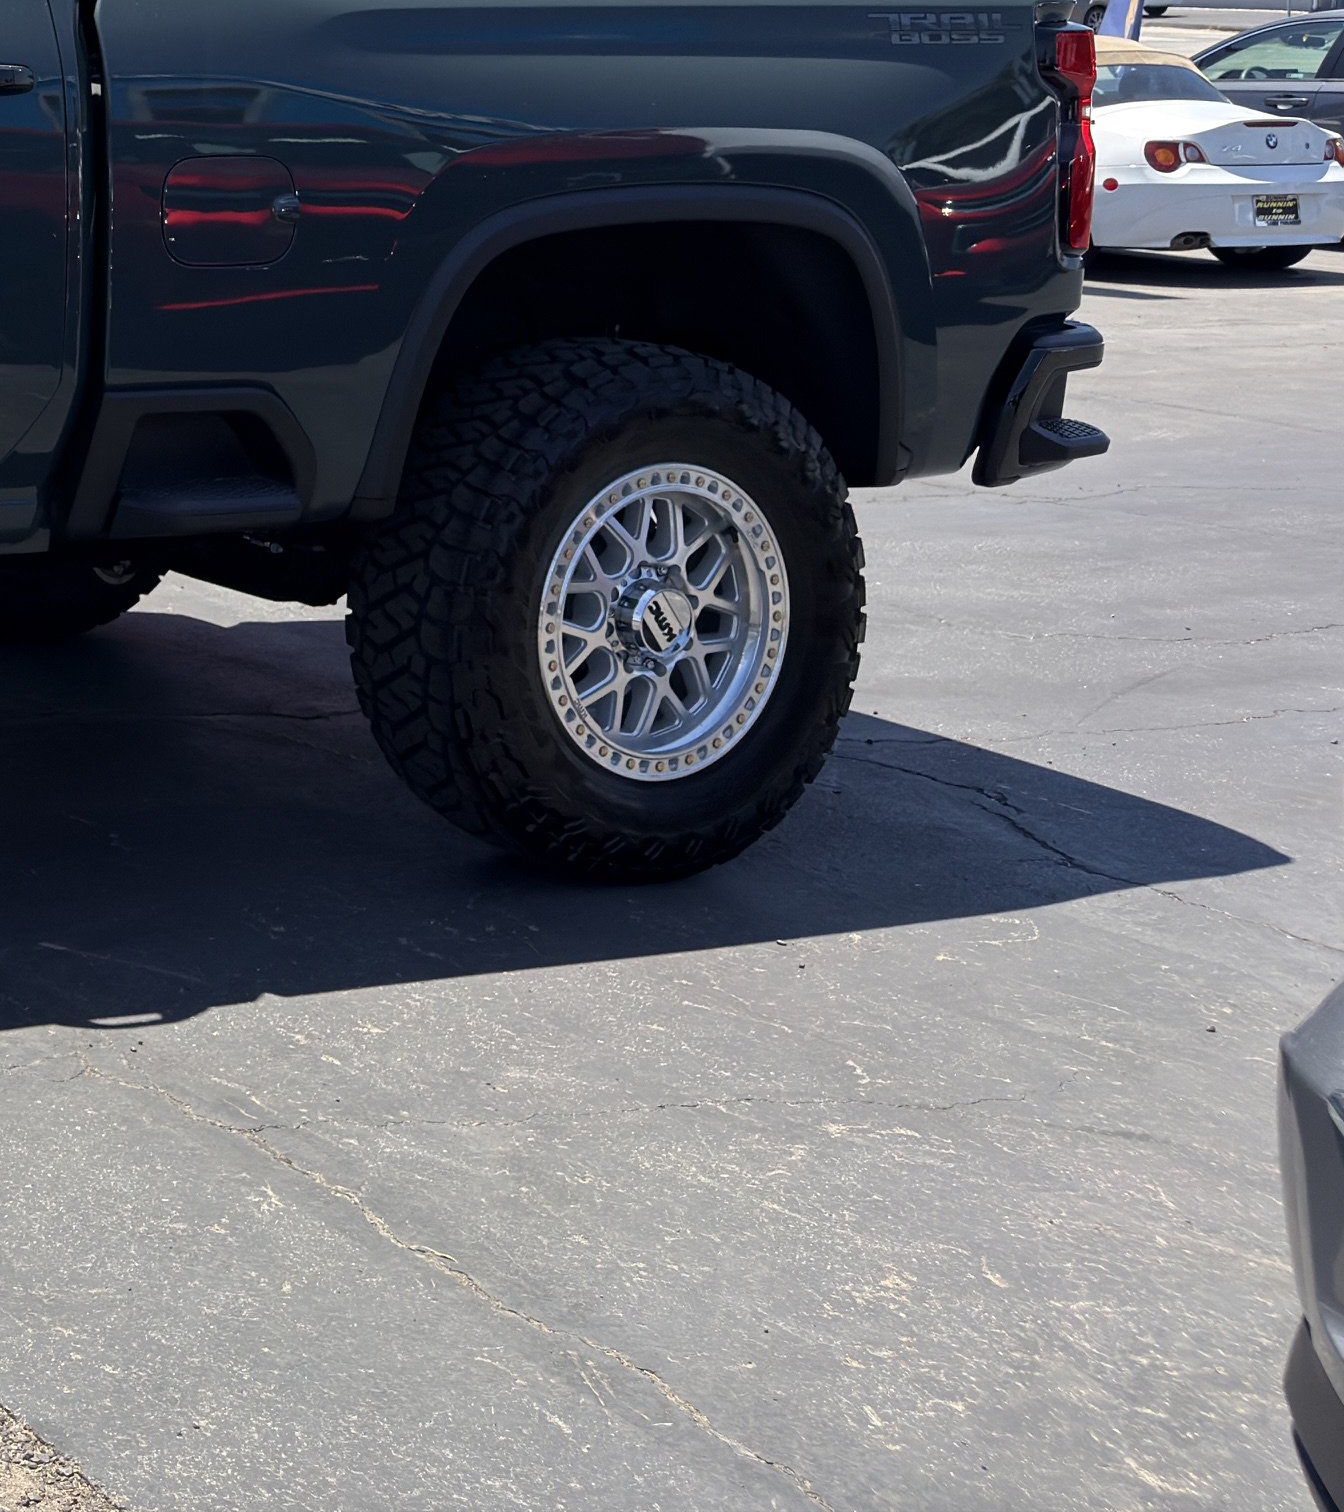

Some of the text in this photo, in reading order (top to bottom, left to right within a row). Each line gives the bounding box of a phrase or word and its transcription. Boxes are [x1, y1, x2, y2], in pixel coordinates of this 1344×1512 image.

[867, 13, 1022, 31] TRAIL
[890, 30, 1005, 45] BOSS
[647, 600, 677, 643] KMC
